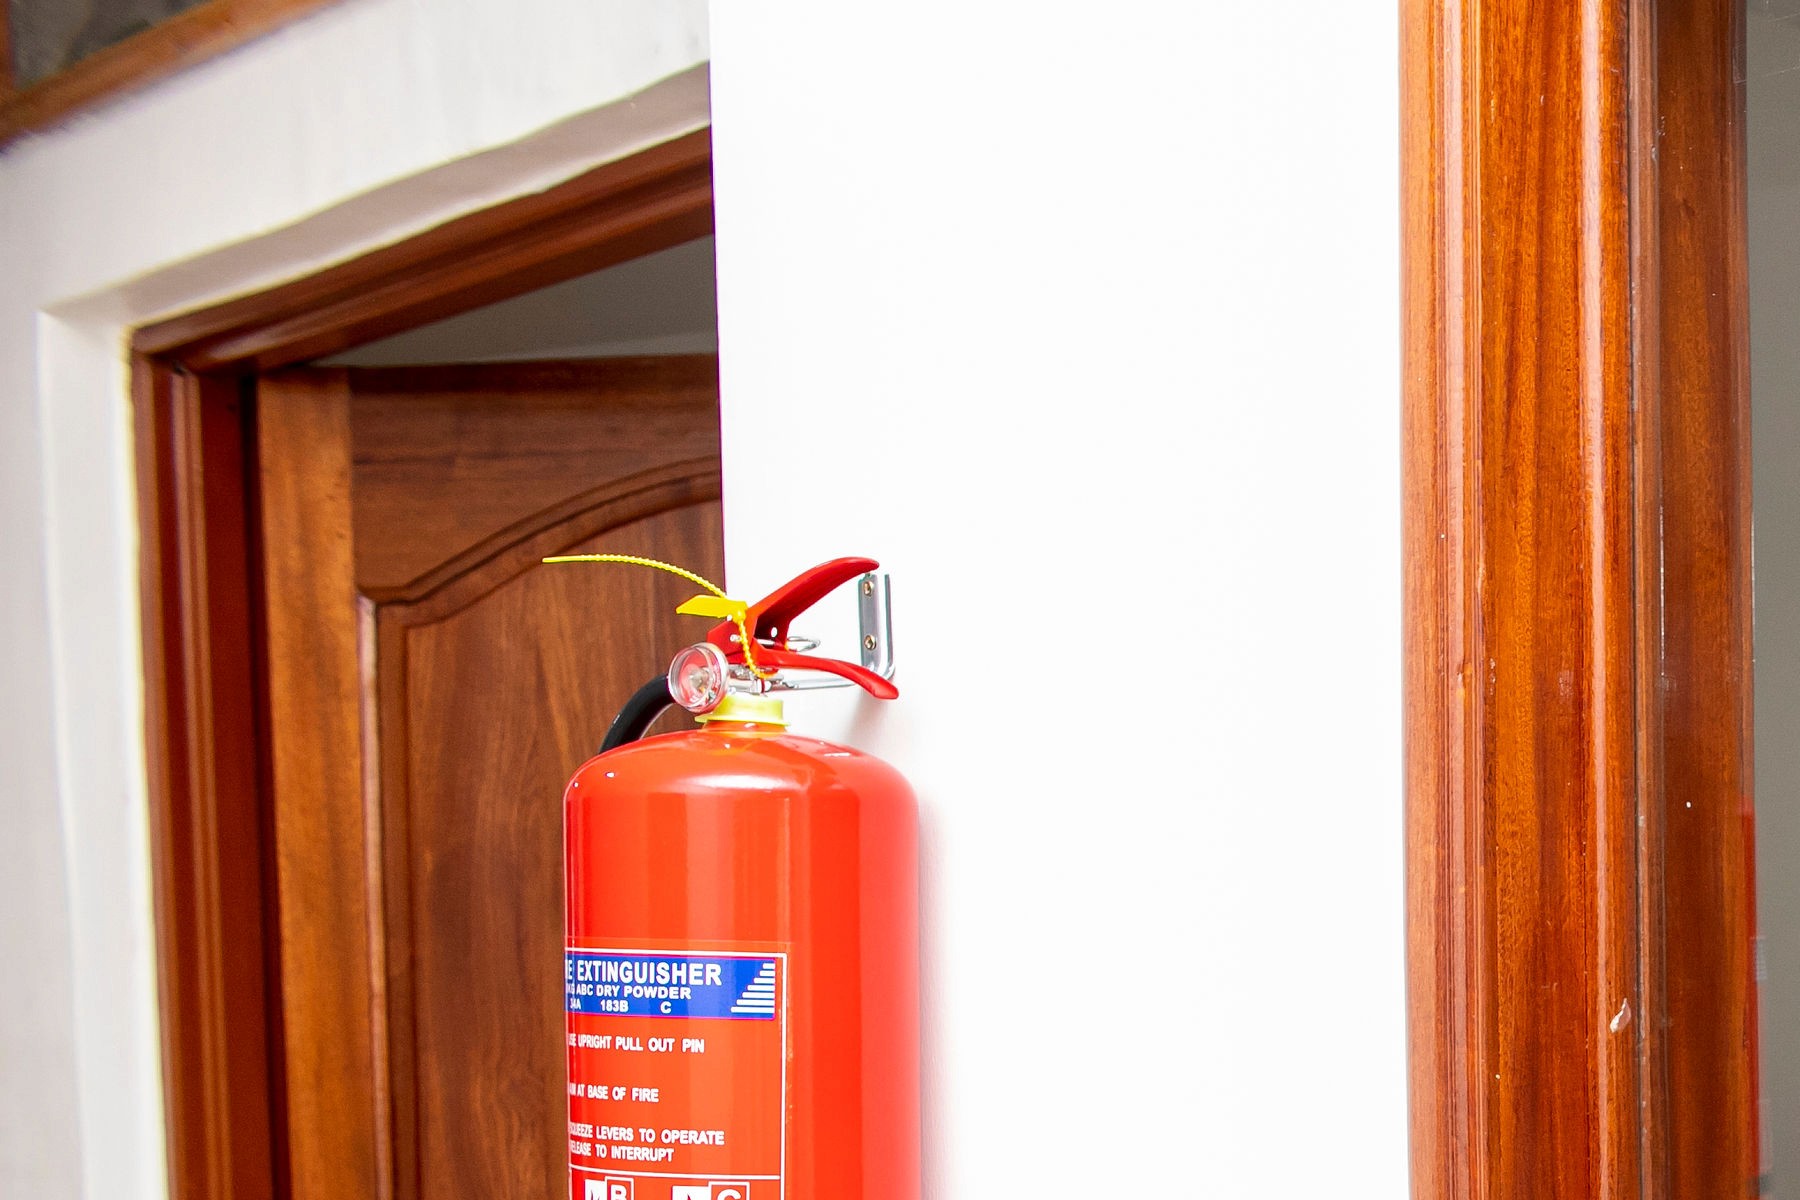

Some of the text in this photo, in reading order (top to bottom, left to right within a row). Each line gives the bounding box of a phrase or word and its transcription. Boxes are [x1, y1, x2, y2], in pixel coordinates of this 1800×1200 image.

[577, 960, 722, 986] EXTINGUISHER
[576, 984, 594, 996] ABC
[596, 984, 620, 997] DRY
[624, 986, 692, 1000] POWDER
[600, 999, 629, 1012] 183B
[660, 1001, 672, 1014] C
[578, 1034, 612, 1049] UPRIGHT
[615, 1036, 643, 1051] PULL
[648, 1037, 675, 1052] OUT
[682, 1038, 705, 1053] PIN
[576, 1083, 585, 1097] AT
[587, 1084, 608, 1100] BASE
[612, 1086, 626, 1101] OF
[632, 1087, 659, 1103] FIRE
[596, 1125, 634, 1142] LEVERS
[639, 1128, 656, 1143] TO
[661, 1129, 725, 1145] OPERATE
[595, 1144, 607, 1158] TO
[611, 1145, 674, 1162] INTERRUPT
